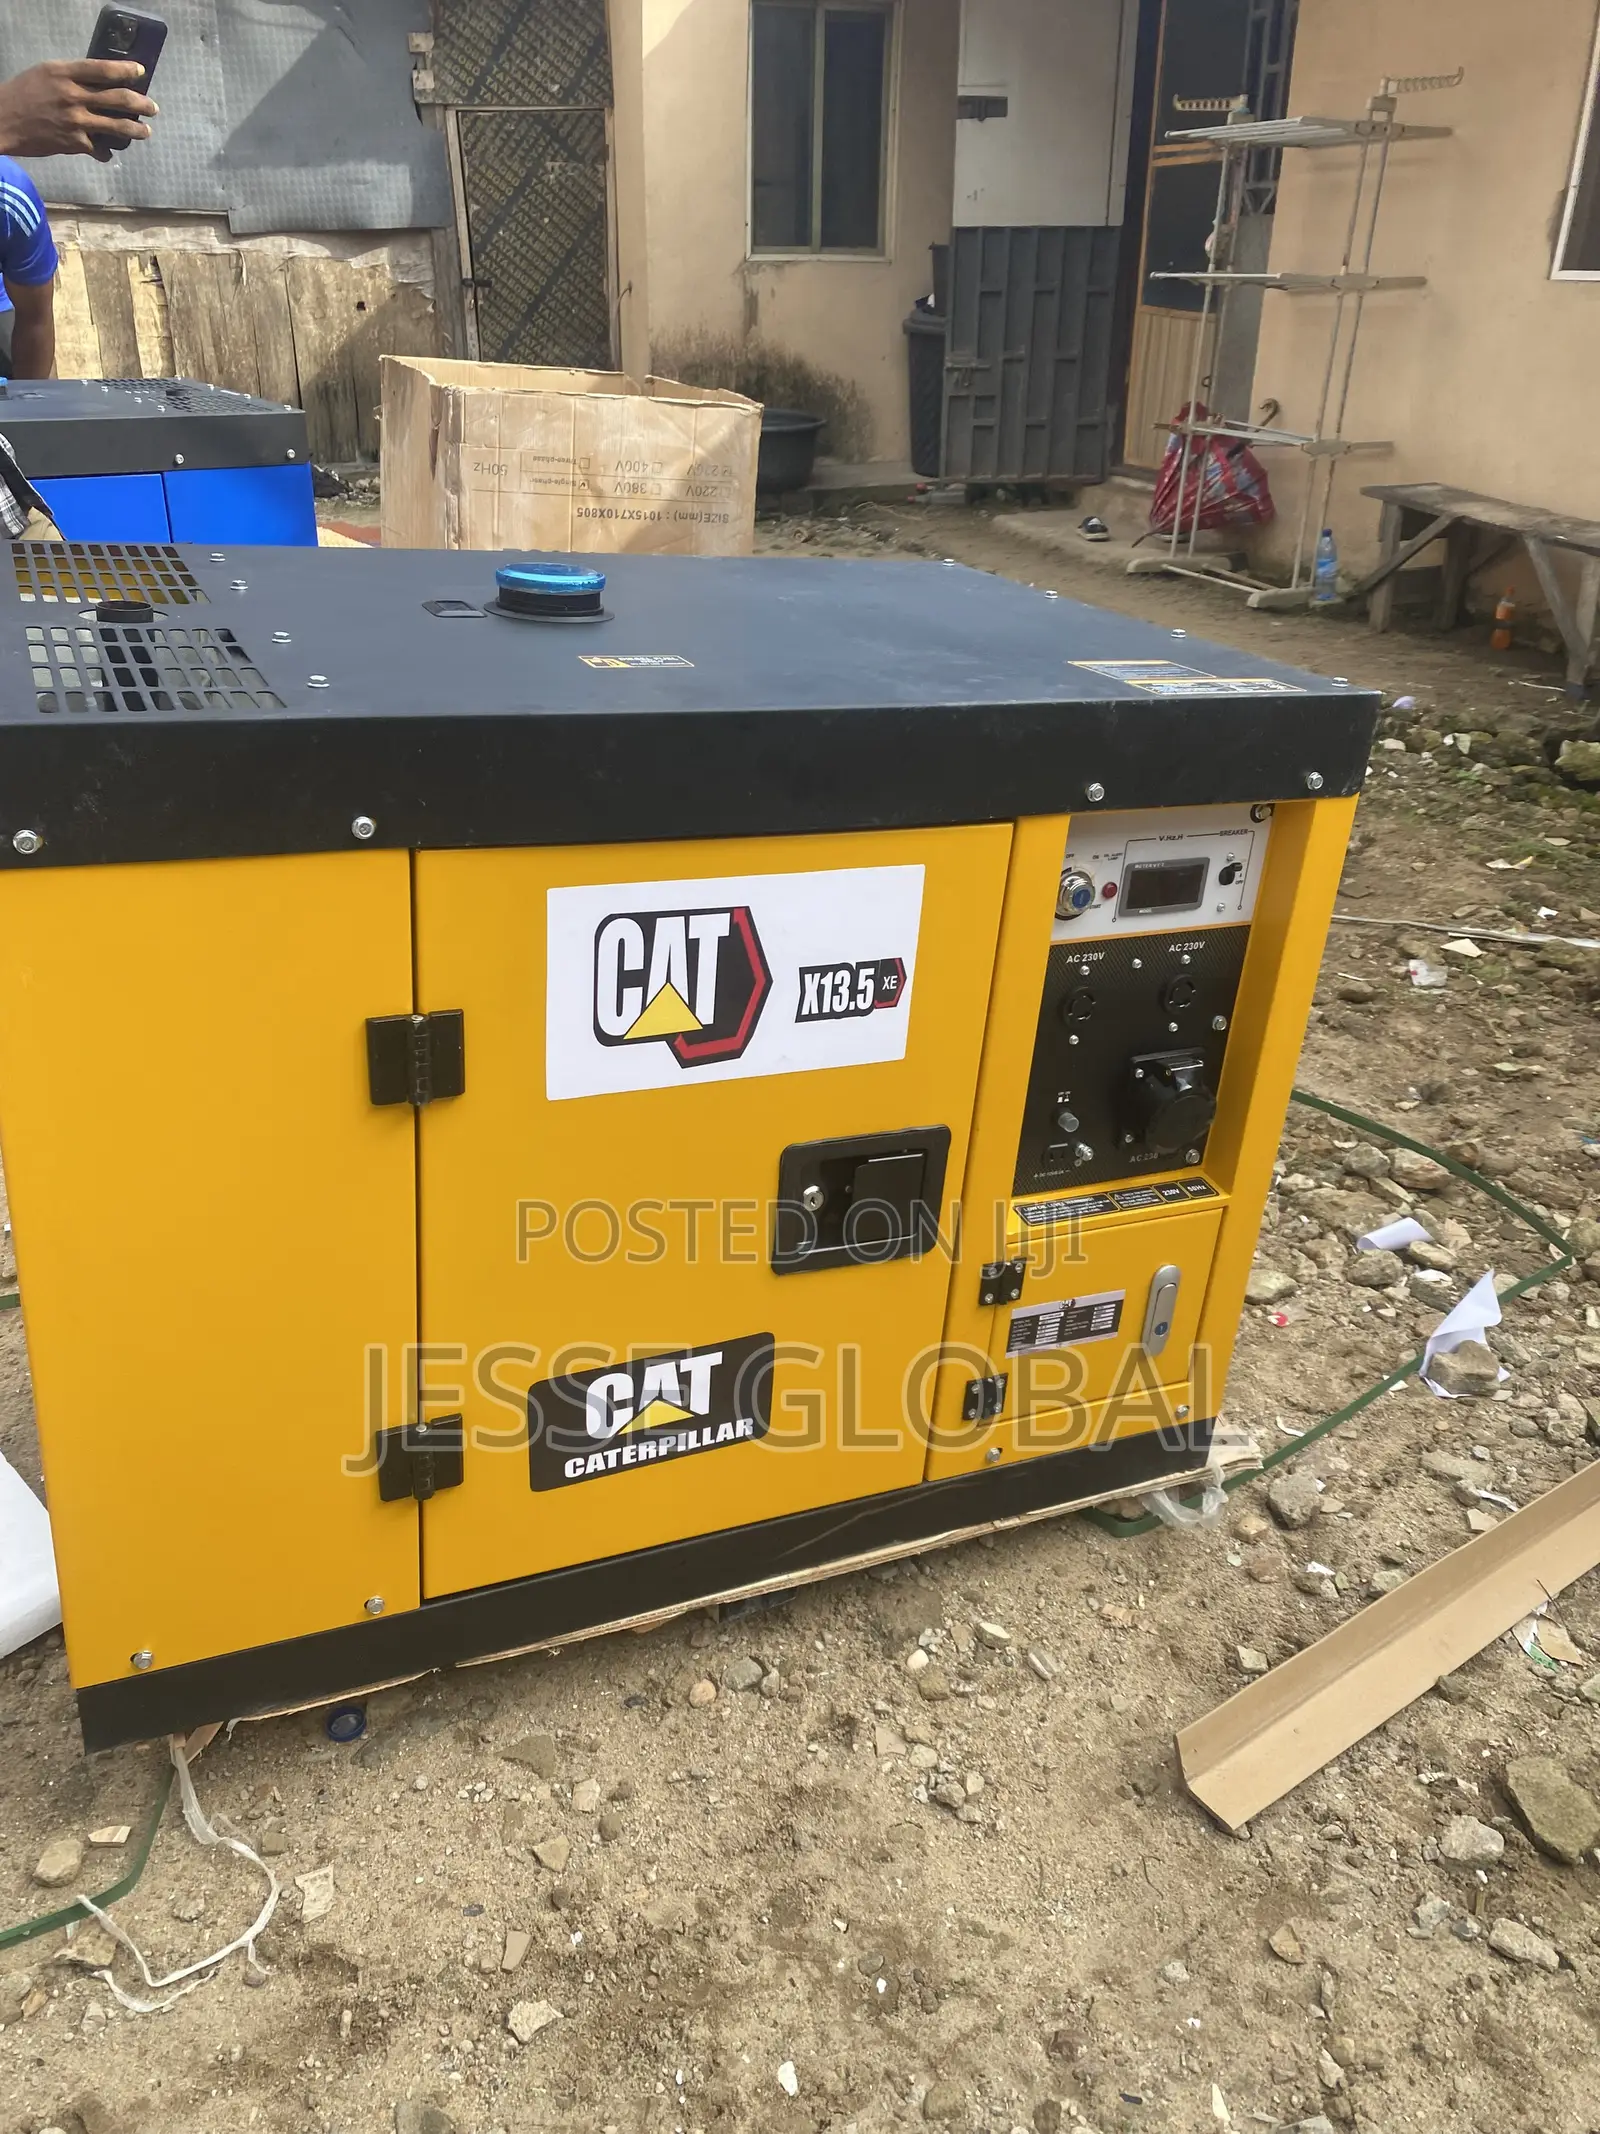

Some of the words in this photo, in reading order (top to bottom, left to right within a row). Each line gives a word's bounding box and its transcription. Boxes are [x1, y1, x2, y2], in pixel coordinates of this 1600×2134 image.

[473, 462, 509, 476] 50Hz
[614, 460, 649, 472] 400V
[614, 482, 647, 494] 380V
[685, 485, 717, 497] 220V
[576, 507, 662, 521] 1015X710X805
[1219, 828, 1249, 837] BREAKER
[1168, 943, 1182, 953] AC
[1183, 940, 1206, 951] 230V
[1066, 954, 1080, 964] AC
[1082, 951, 1105, 962] 230V
[598, 913, 731, 1037] CAT
[800, 967, 876, 1016] X13.5
[881, 974, 898, 992] XE
[586, 1351, 723, 1440] CAT
[564, 1417, 754, 1479] CATERPILLAR
